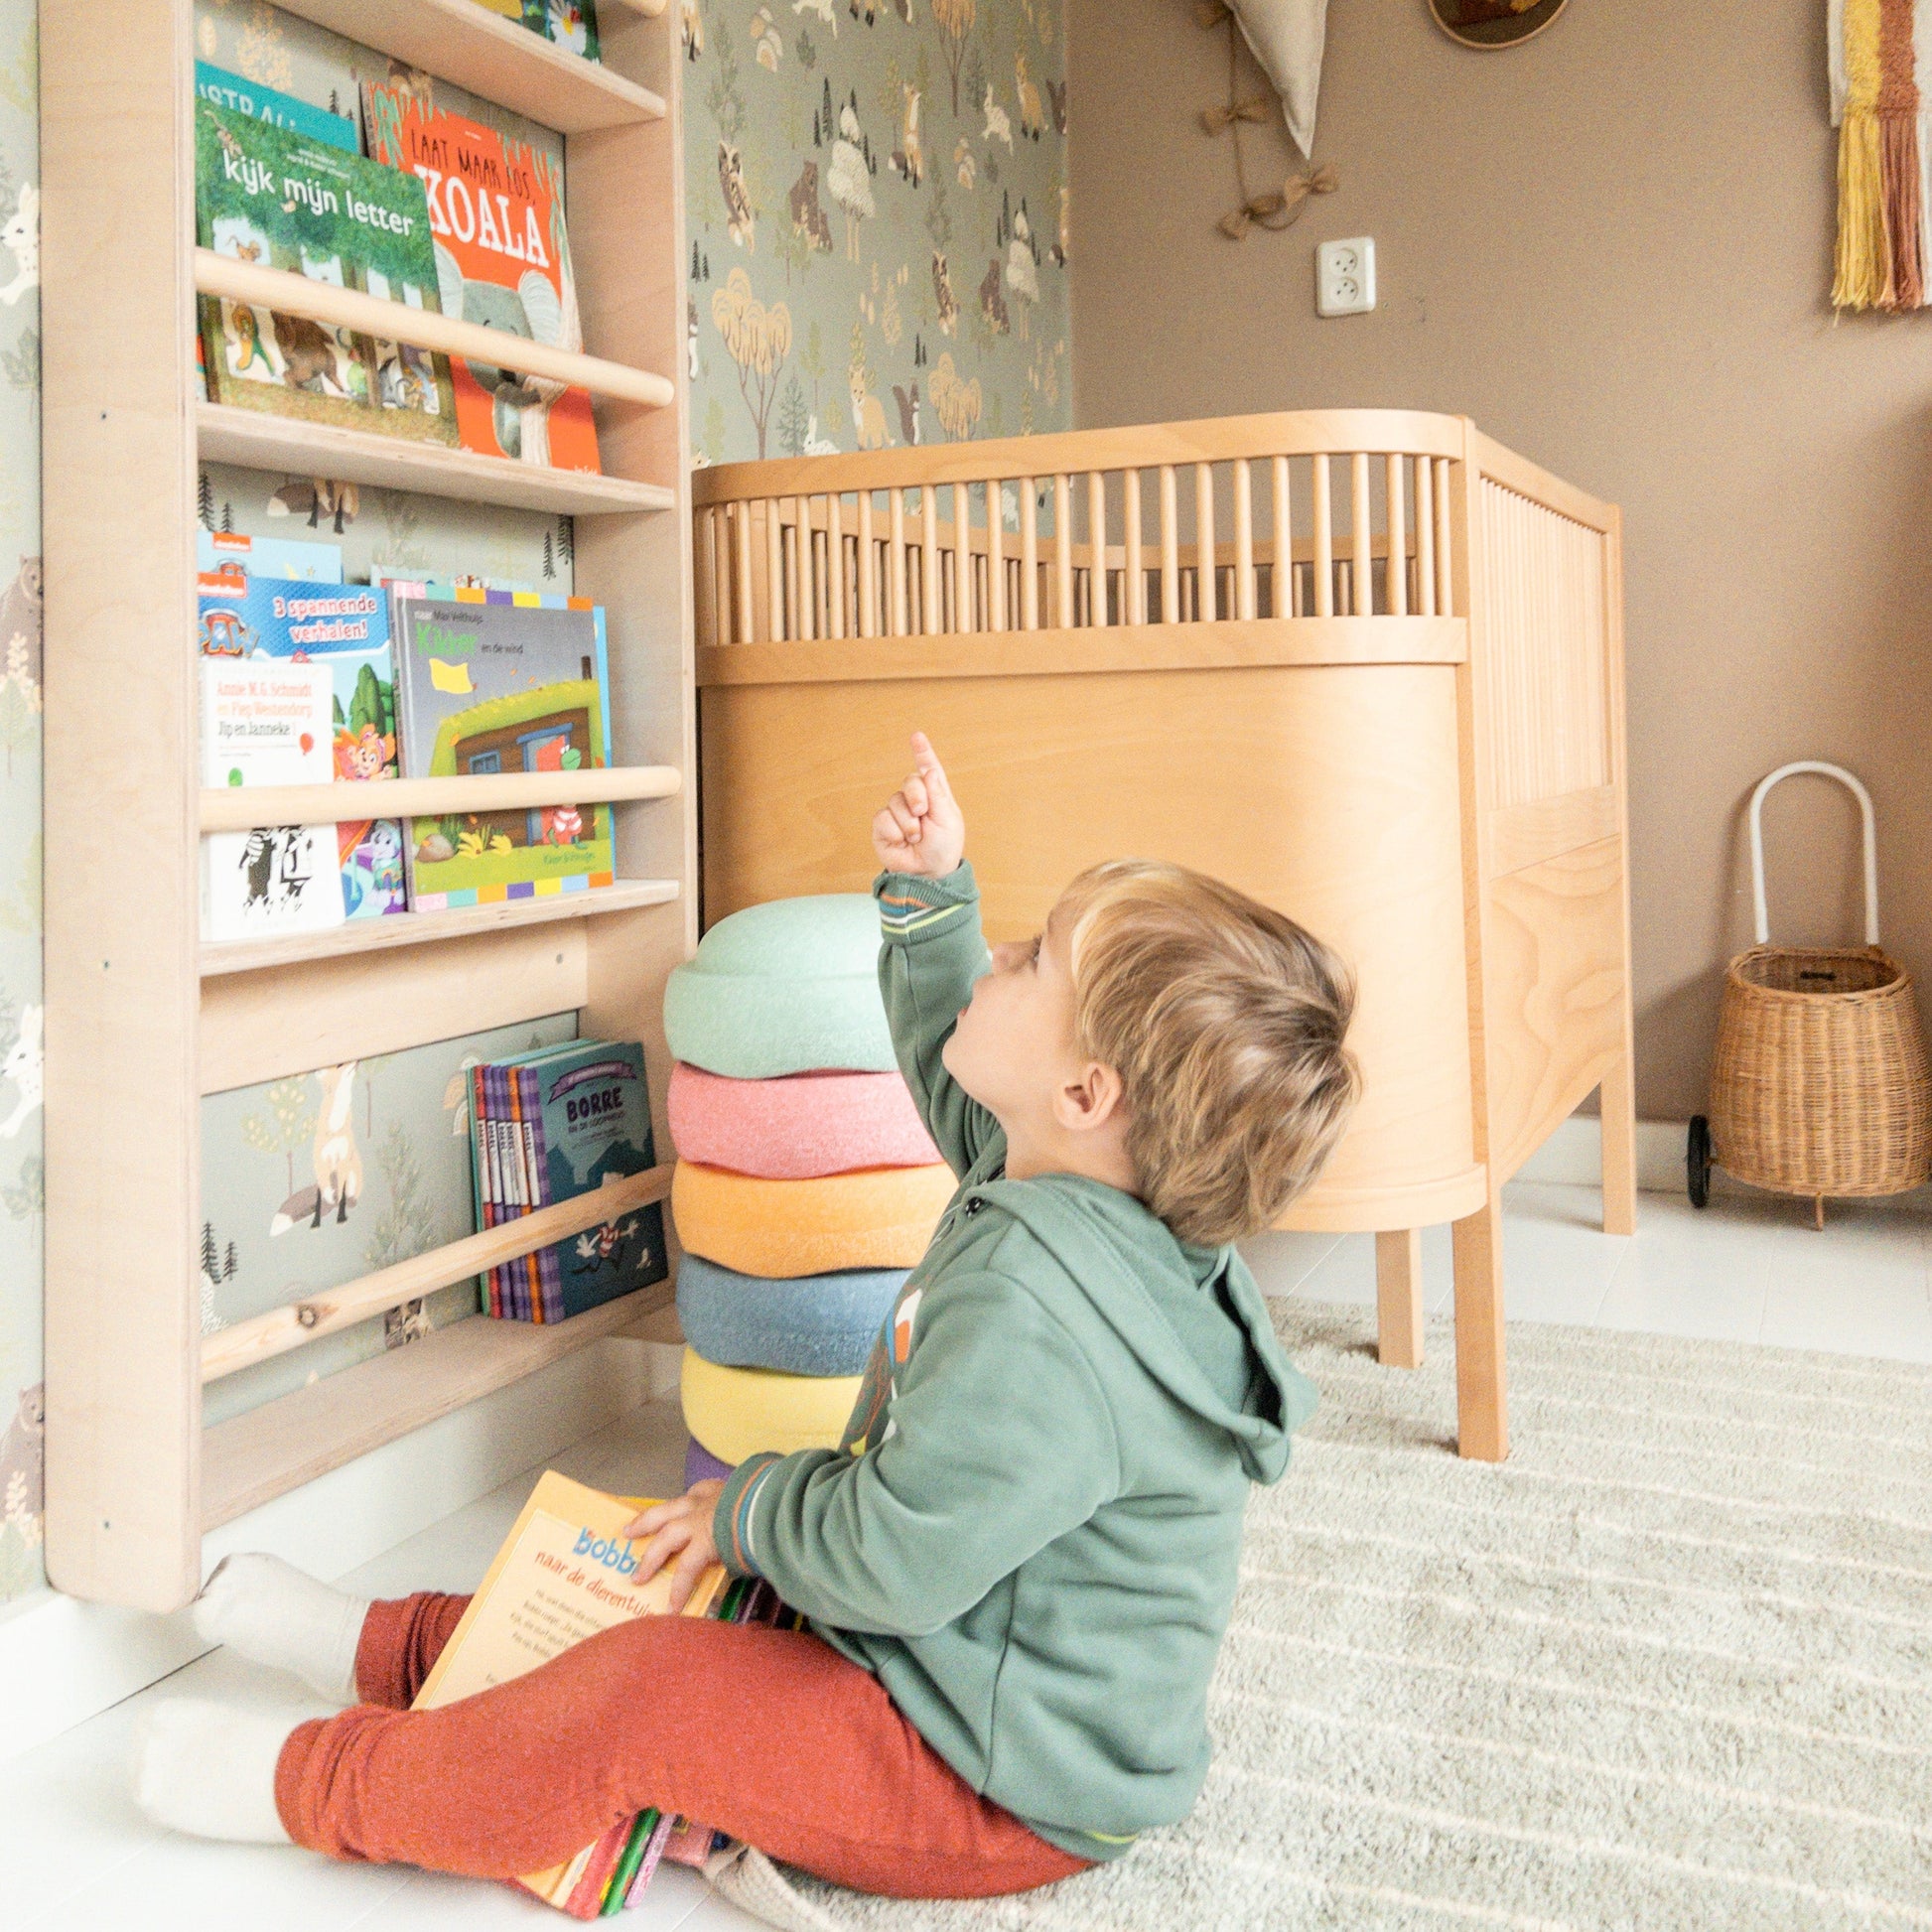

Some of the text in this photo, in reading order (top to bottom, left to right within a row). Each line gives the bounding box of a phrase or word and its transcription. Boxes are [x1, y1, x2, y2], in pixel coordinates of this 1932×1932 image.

[411, 129, 448, 169] LAAT
[458, 147, 501, 189] MAAR
[283, 177, 339, 216] mijn
[345, 190, 414, 236] letter
[413, 164, 550, 268] KOALA
[273, 594, 377, 621] 3 spannende
[289, 620, 368, 643] verhalen!
[567, 1086, 623, 1122] BORRE
[534, 1551, 569, 1576] naar
[566, 1567, 586, 1587] de
[586, 1578, 651, 1616] dierentui
